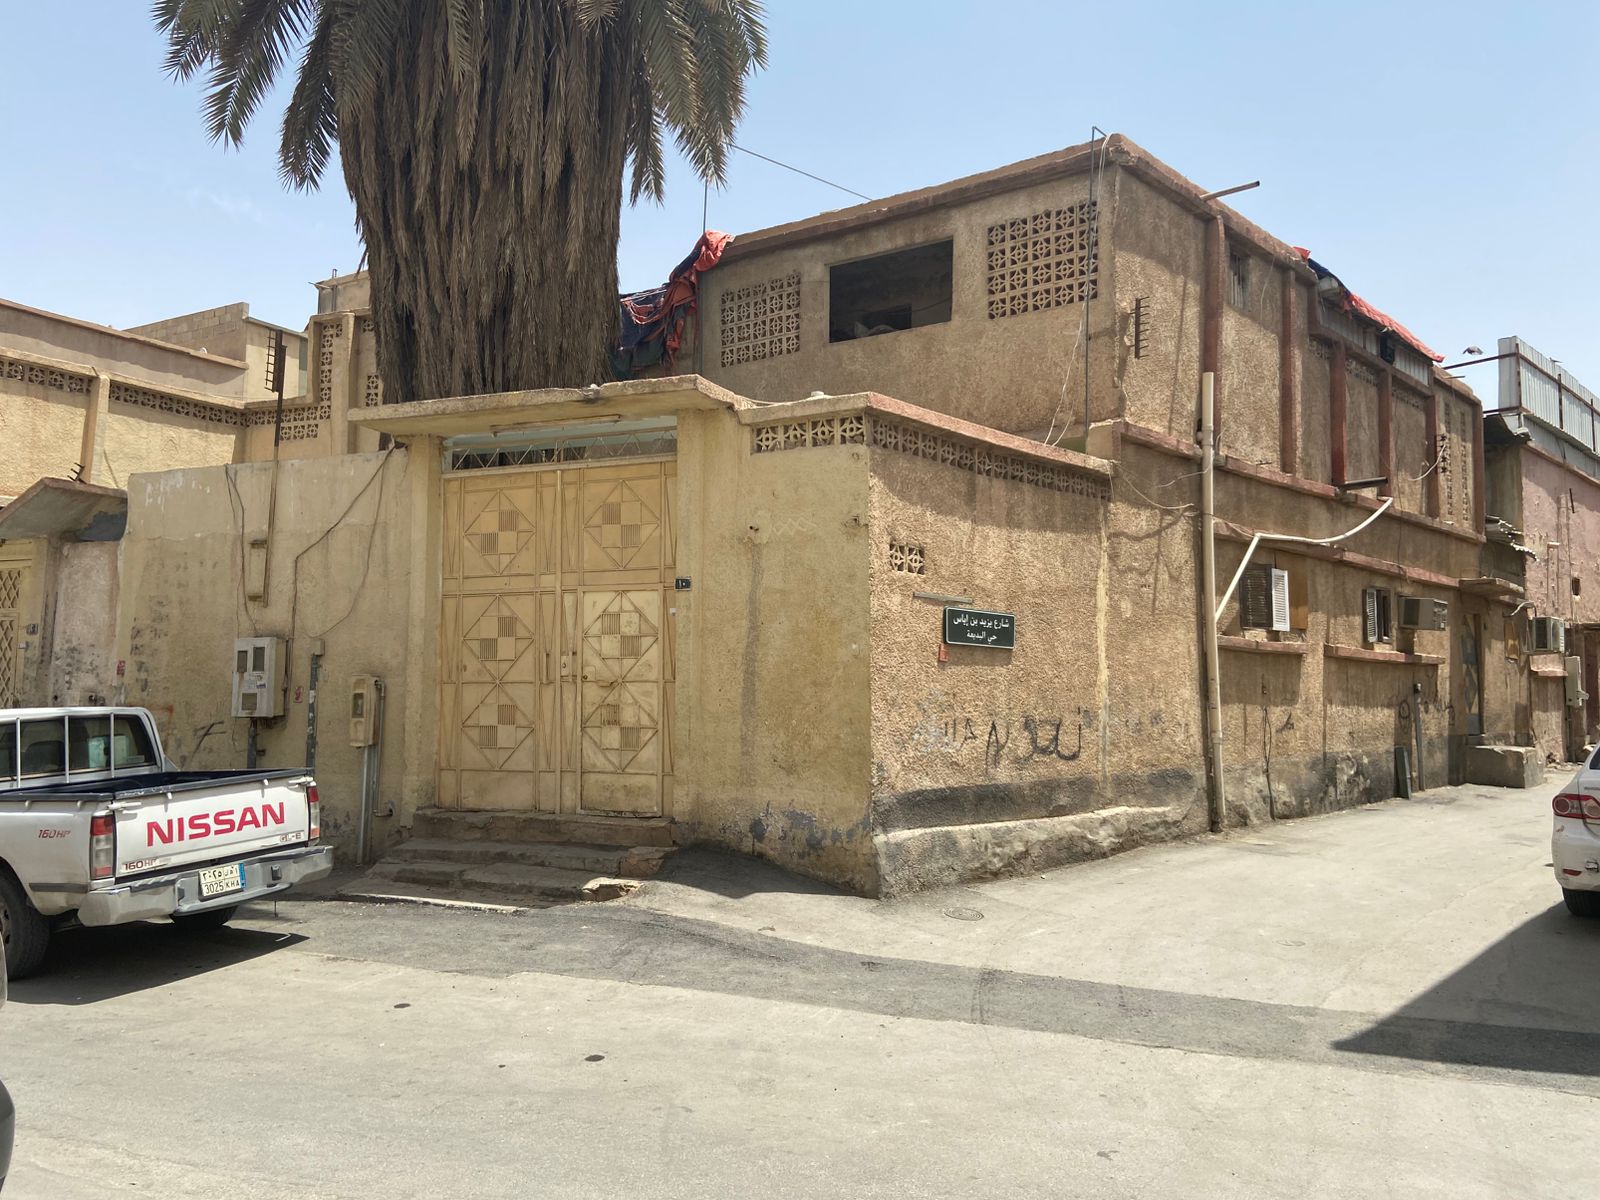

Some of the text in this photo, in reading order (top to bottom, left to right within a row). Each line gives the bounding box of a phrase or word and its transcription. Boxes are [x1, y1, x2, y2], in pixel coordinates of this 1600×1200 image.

[970, 617, 978, 626] بن
[980, 618, 993, 628] يزيد
[994, 618, 1010, 629] شارع
[967, 630, 997, 644] حي البديعة
[147, 802, 285, 847] NISSAN
[39, 829, 71, 839] 160HP
[205, 879, 240, 894] 3025 KHA
